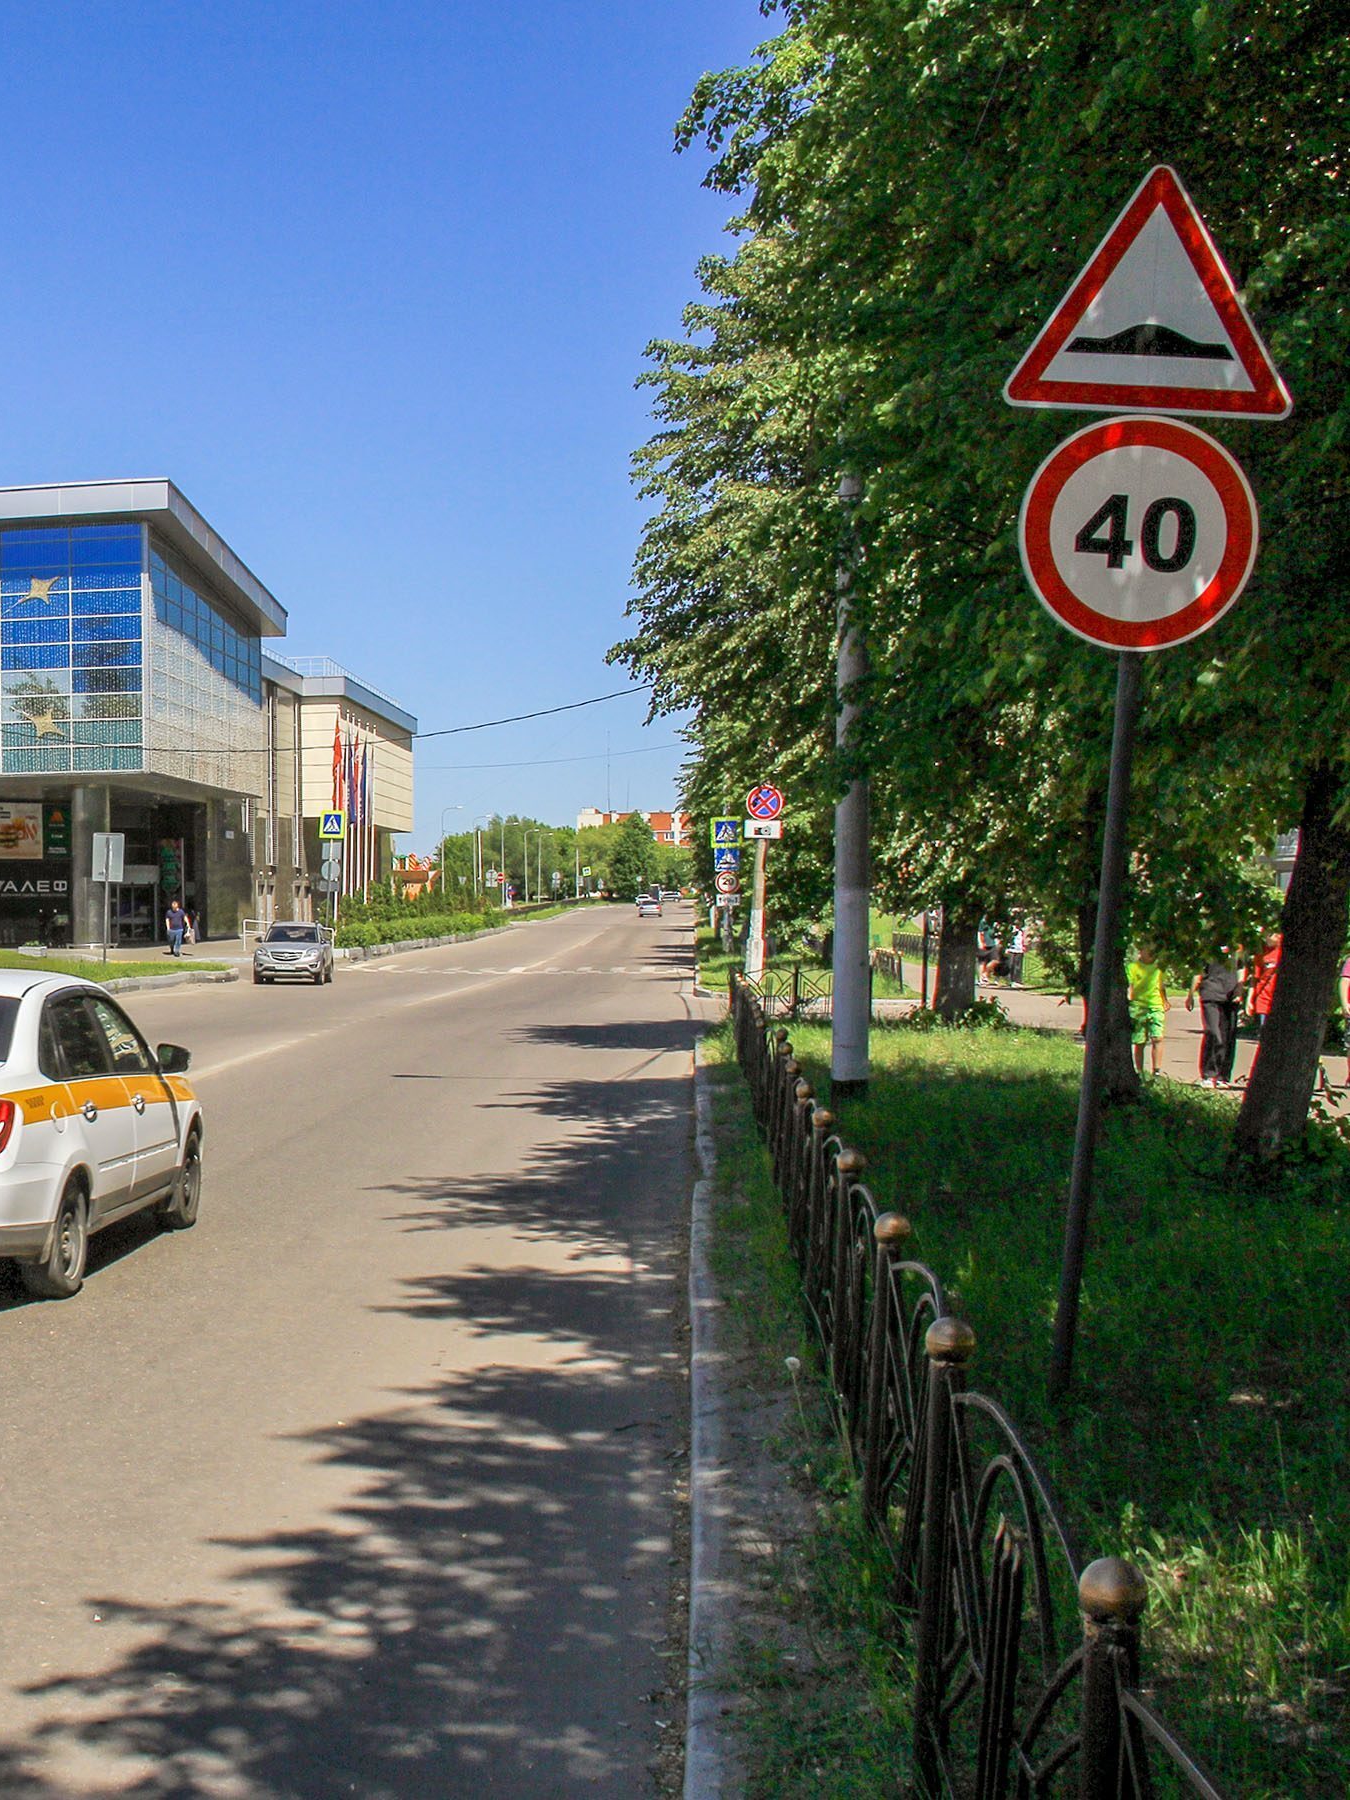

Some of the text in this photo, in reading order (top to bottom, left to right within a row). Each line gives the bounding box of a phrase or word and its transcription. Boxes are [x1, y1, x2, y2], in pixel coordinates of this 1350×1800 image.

[1074, 494, 1196, 573] 40
[3, 880, 67, 892] АЛЕФ
[722, 876, 735, 886] 20
